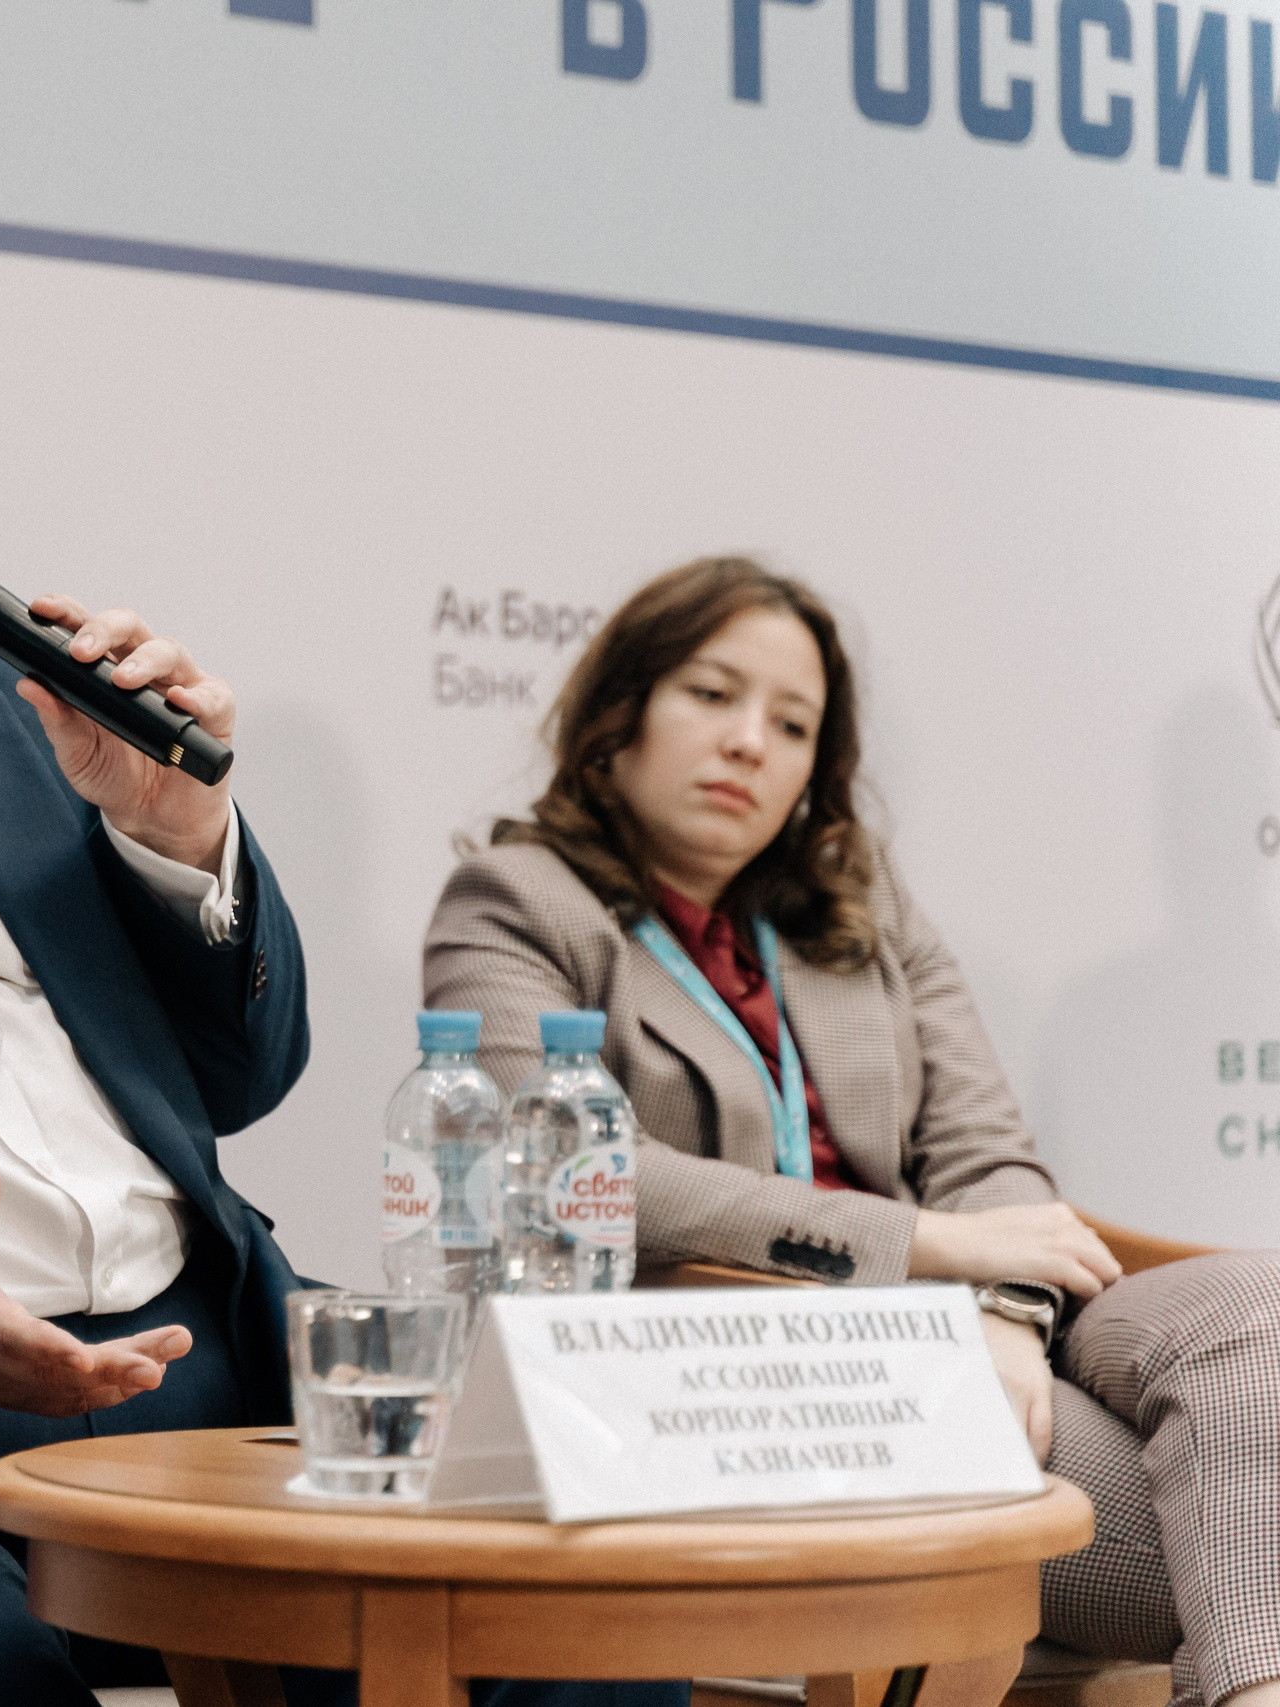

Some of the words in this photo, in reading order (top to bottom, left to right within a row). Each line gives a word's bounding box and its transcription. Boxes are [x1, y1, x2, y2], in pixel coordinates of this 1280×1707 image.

[432, 586, 489, 635] Ак
[434, 653, 536, 708] Банк
[550, 1313, 768, 1354] ВЛАДИМИР
[779, 1310, 958, 1345] КОЗИНЕЦ
[679, 1359, 890, 1392] АССОЦИАЦИЯ
[648, 1398, 926, 1437] КОРПОРАТИВНЫХ
[714, 1441, 893, 1475] КАЗНАЧЕЕВ
